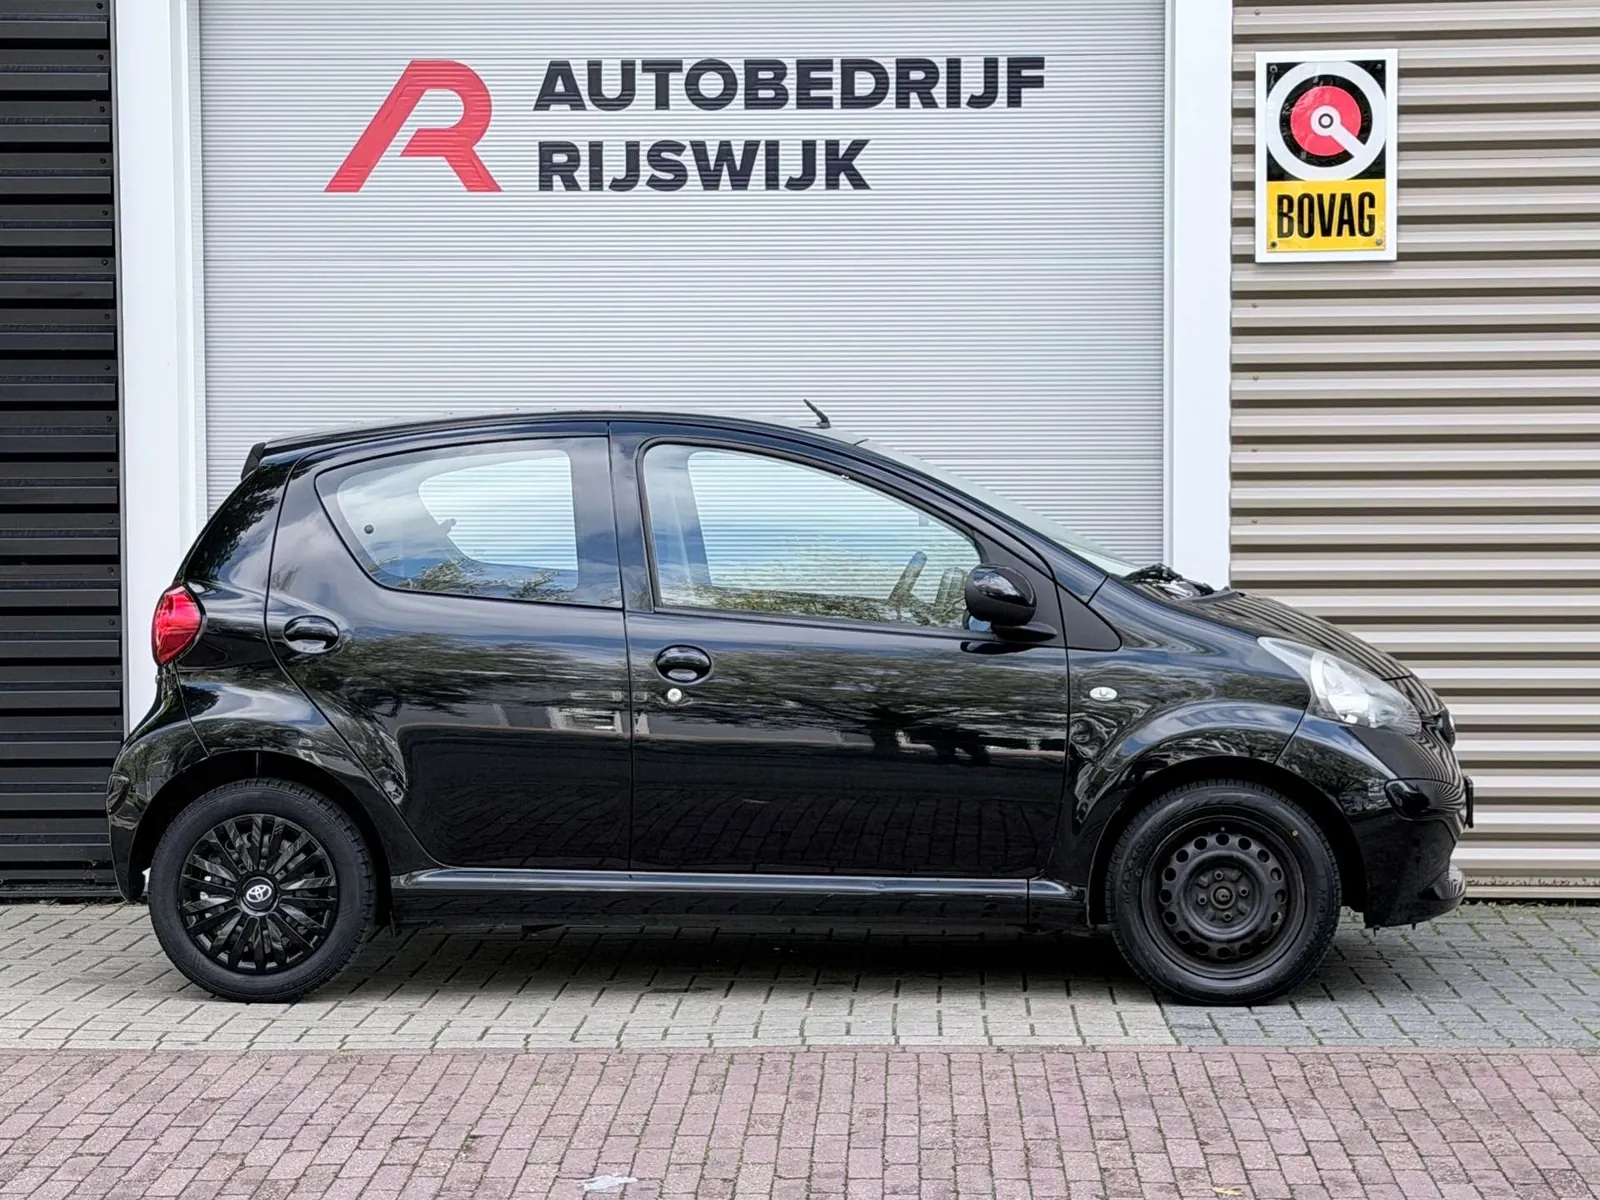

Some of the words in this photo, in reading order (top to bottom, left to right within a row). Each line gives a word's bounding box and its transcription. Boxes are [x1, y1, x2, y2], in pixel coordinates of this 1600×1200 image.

[533, 56, 1045, 111] AUTOBEDRIJF
[538, 139, 870, 192] RIJSWIJK
[1277, 191, 1376, 239] BOVAG
